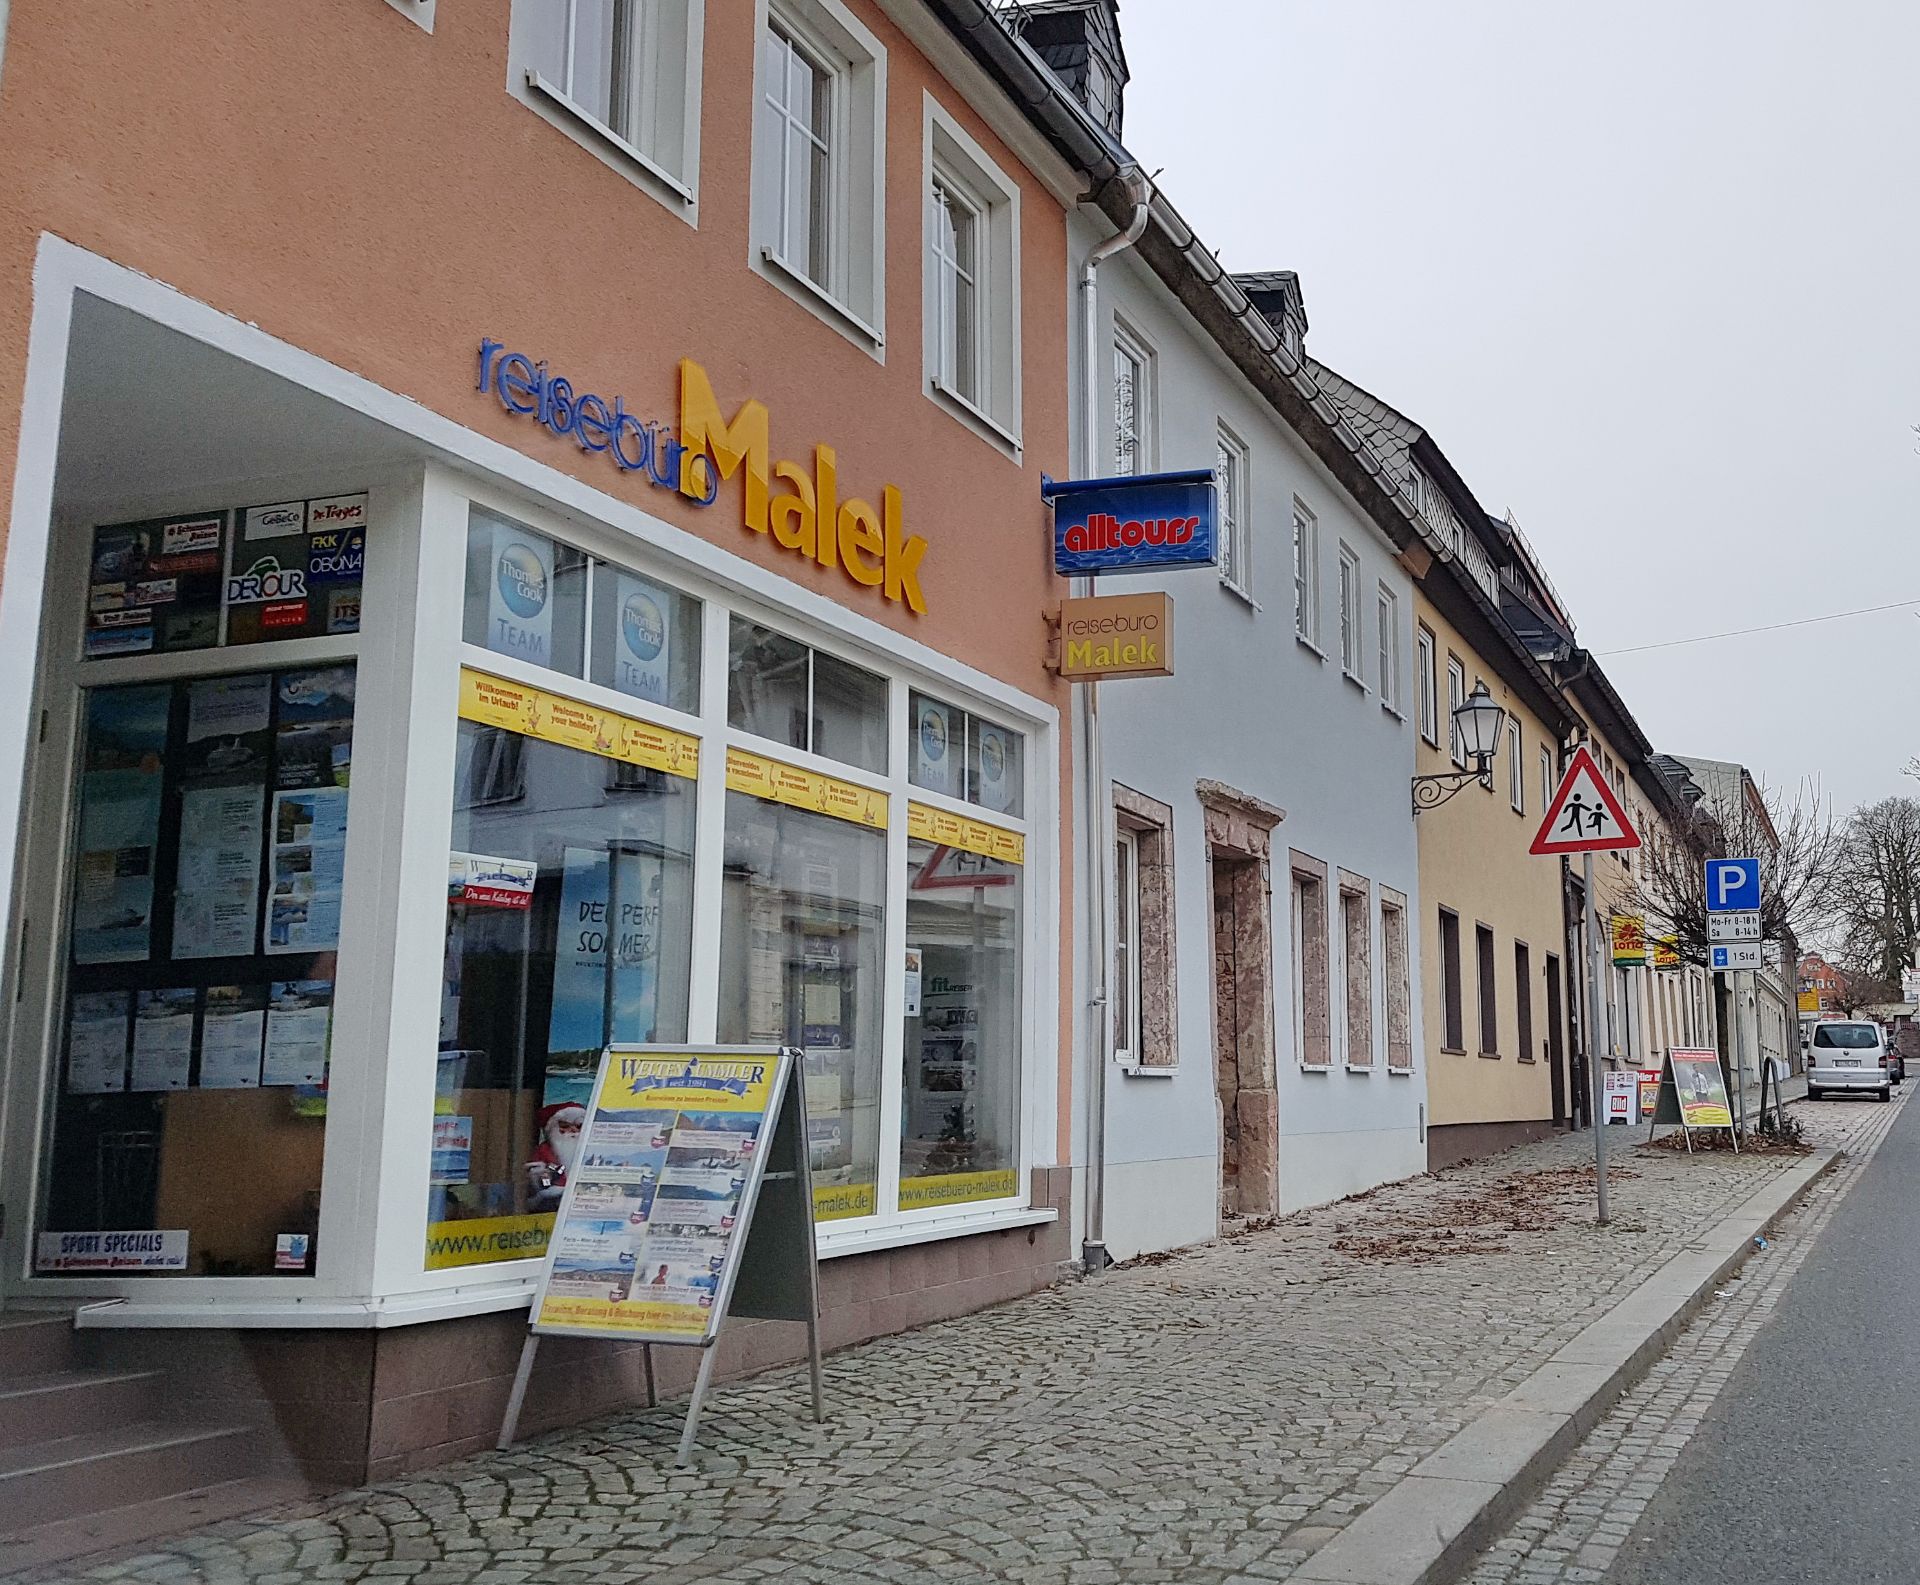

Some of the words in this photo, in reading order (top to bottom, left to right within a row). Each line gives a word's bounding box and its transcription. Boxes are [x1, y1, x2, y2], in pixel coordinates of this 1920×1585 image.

[477, 337, 719, 508] reisebüro
[679, 356, 928, 616] Malek
[312, 535, 338, 548] FKK
[1064, 513, 1200, 552] alltours
[311, 553, 362, 573] OBONA
[502, 559, 545, 589] Thomas
[517, 582, 544, 604] Cook
[625, 607, 662, 634] Thomas
[497, 618, 543, 652] TEAM
[638, 626, 662, 646] Cook
[1067, 635, 1159, 669] Malek
[623, 660, 661, 693] TEAM
[475, 681, 523, 701] Willkommen
[479, 693, 489, 704] im
[491, 695, 519, 711] Urlaub!
[552, 704, 584, 719] Welcome
[586, 712, 594, 721] to
[551, 715, 567, 727] your
[568, 718, 597, 734] holiday!
[1719, 865, 1747, 904] P
[579, 900, 609, 922] DE
[1711, 917, 1731, 926] Mo-Fr
[1752, 916, 1757, 924] h
[1711, 928, 1720, 937] Sa
[1735, 928, 1751, 936] 8-14
[1753, 927, 1758, 935] h
[1614, 942, 1643, 950] LOTTO
[1733, 952, 1737, 961] 1
[1739, 951, 1757, 961] Std.
[1612, 1097, 1626, 1111] Bild
[899, 1177, 1014, 1200] www.reisebuero-malek.de
[62, 1235, 101, 1254] SPORT
[104, 1234, 163, 1253] SPECIALS
[426, 1222, 552, 1257] www.reiseb
